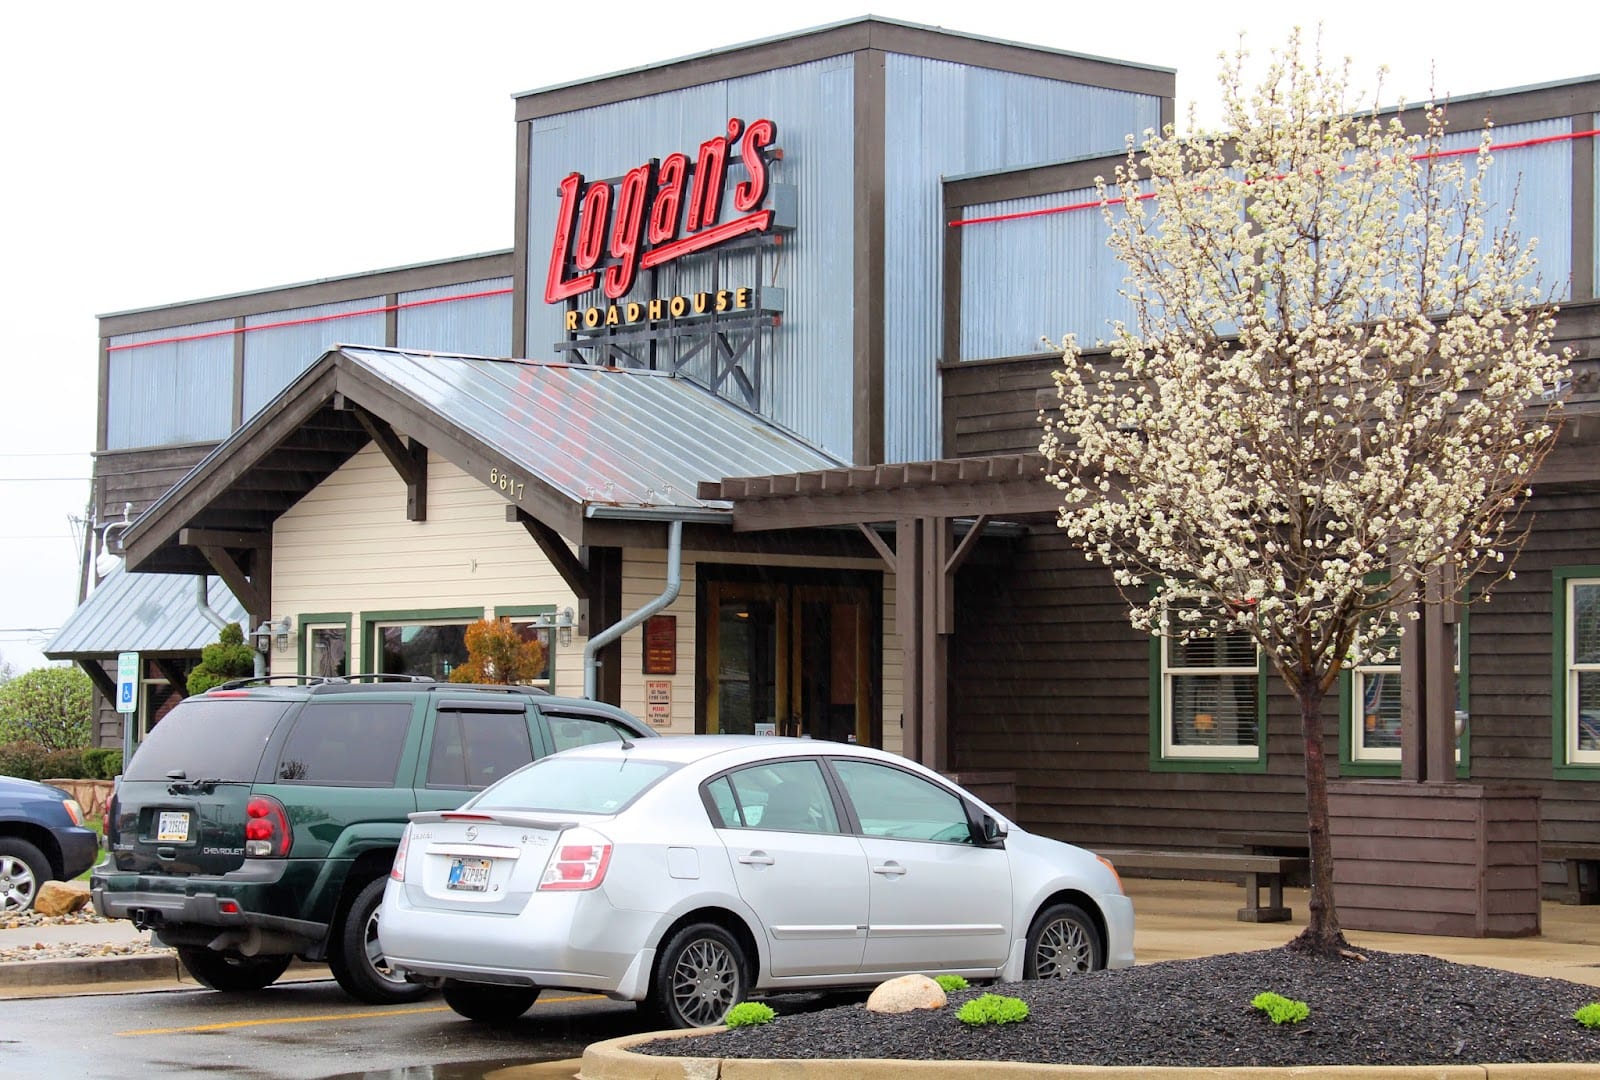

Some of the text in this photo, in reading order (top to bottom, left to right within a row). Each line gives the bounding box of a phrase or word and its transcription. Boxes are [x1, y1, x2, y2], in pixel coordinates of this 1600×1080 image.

[545, 117, 776, 304] Logan's
[566, 287, 749, 330] ROADHOUSE
[490, 467, 524, 500] 6617
[203, 847, 245, 856] CHEVROLET
